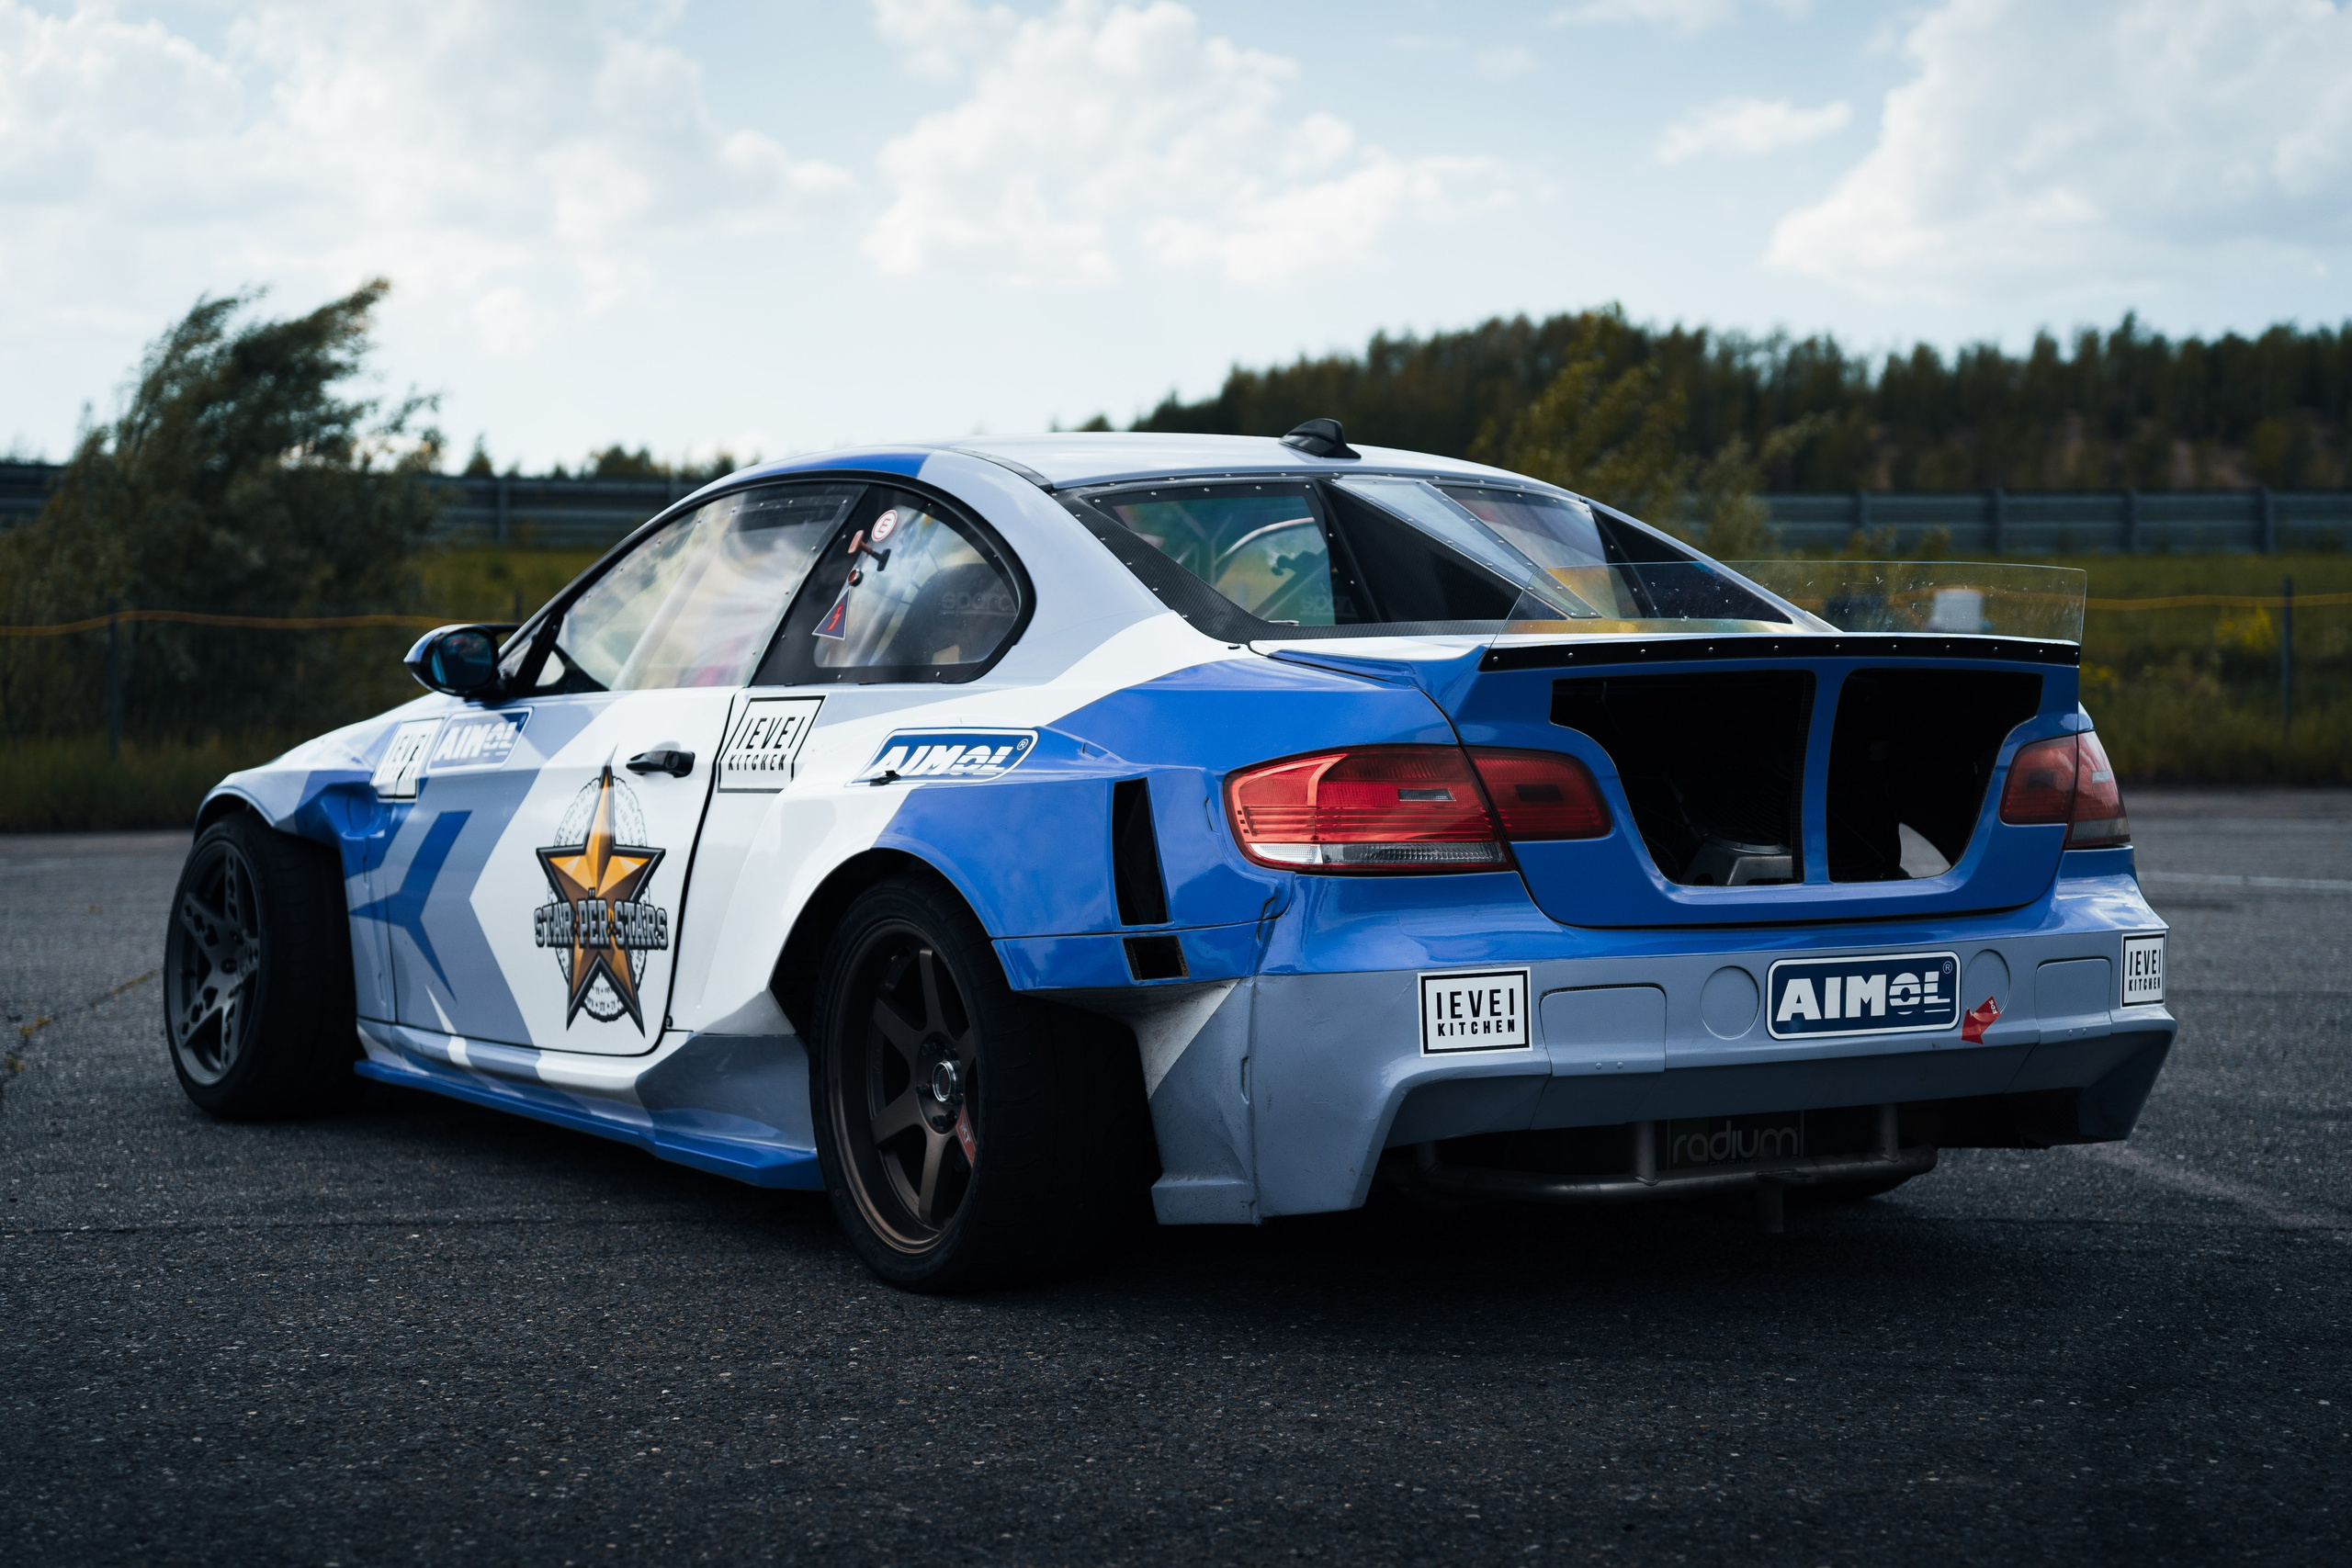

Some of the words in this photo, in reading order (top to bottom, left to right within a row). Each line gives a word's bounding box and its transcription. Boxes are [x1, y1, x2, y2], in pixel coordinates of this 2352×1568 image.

[728, 753, 787, 771] KITCHEN
[534, 901, 575, 948] STAR
[614, 900, 669, 951] STARS
[1775, 970, 1951, 1022] AIMOL
[2128, 976, 2161, 992] KITCHEN
[1437, 1019, 1515, 1037] KITCHEN
[1672, 1119, 1799, 1164] radium
